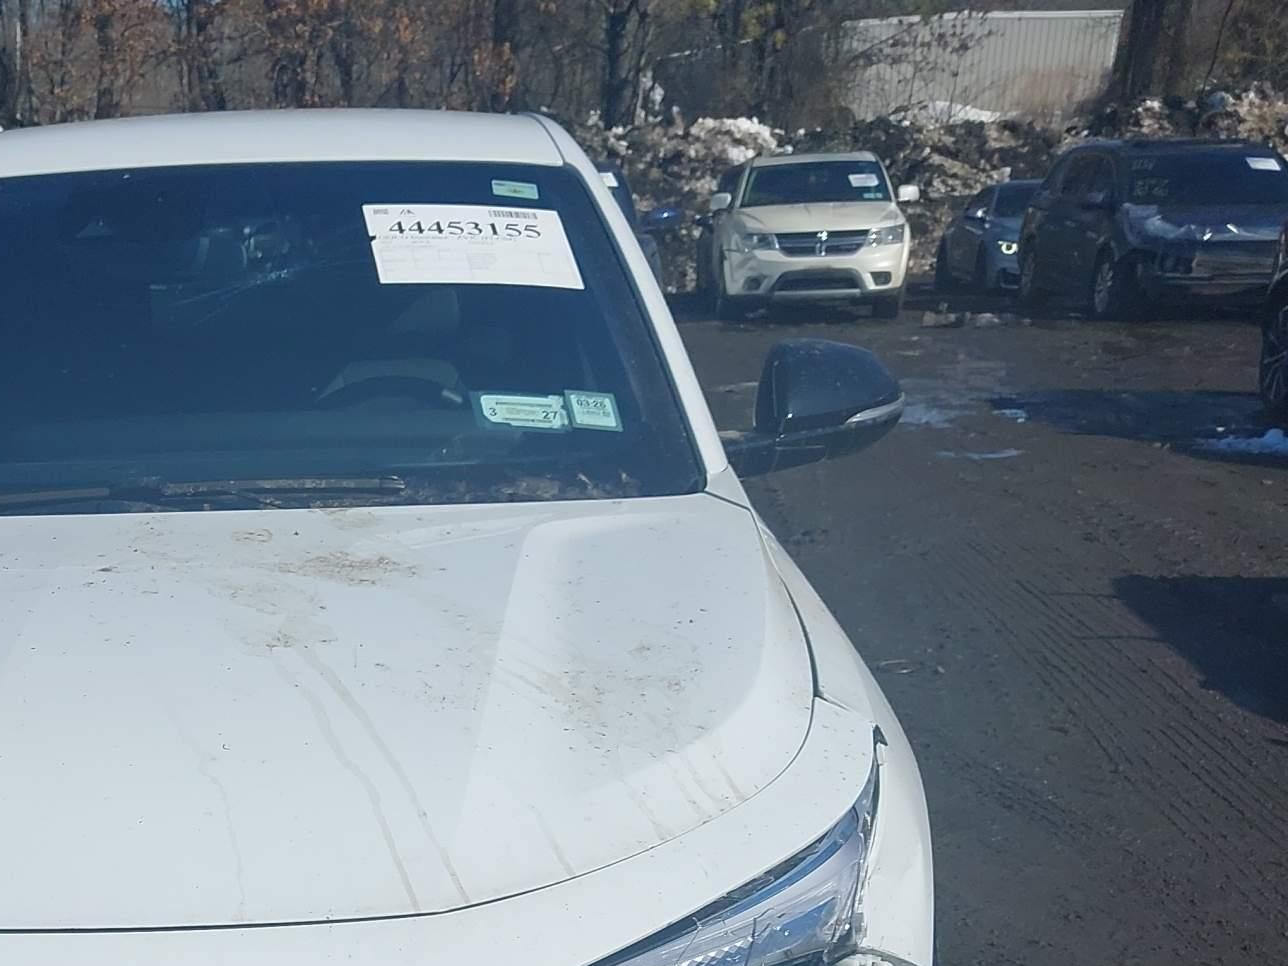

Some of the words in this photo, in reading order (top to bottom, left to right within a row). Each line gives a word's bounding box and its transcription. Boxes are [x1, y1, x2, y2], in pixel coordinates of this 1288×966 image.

[389, 220, 541, 239] 44453155
[488, 407, 497, 416] 3
[541, 410, 558, 420] 27
